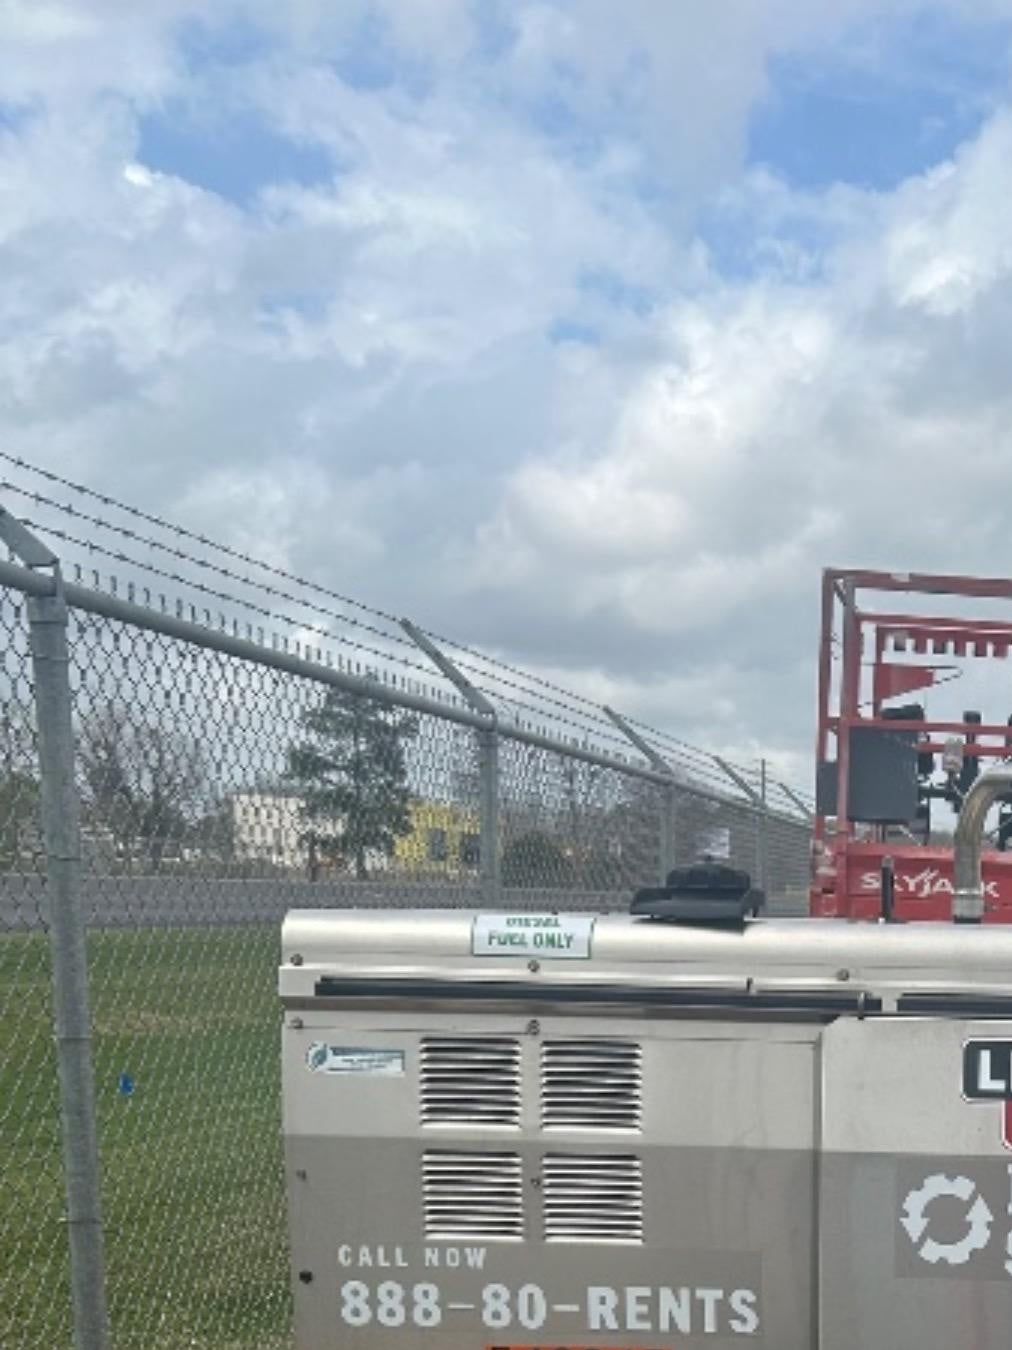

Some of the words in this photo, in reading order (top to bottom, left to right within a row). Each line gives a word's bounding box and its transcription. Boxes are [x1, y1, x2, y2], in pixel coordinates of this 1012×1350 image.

[488, 931, 527, 947] FUEL
[533, 933, 573, 949] ONLY
[338, 1244, 409, 1267] CALL
[424, 1246, 488, 1269] NOW
[340, 1279, 760, 1335] 888-80-RENTS
